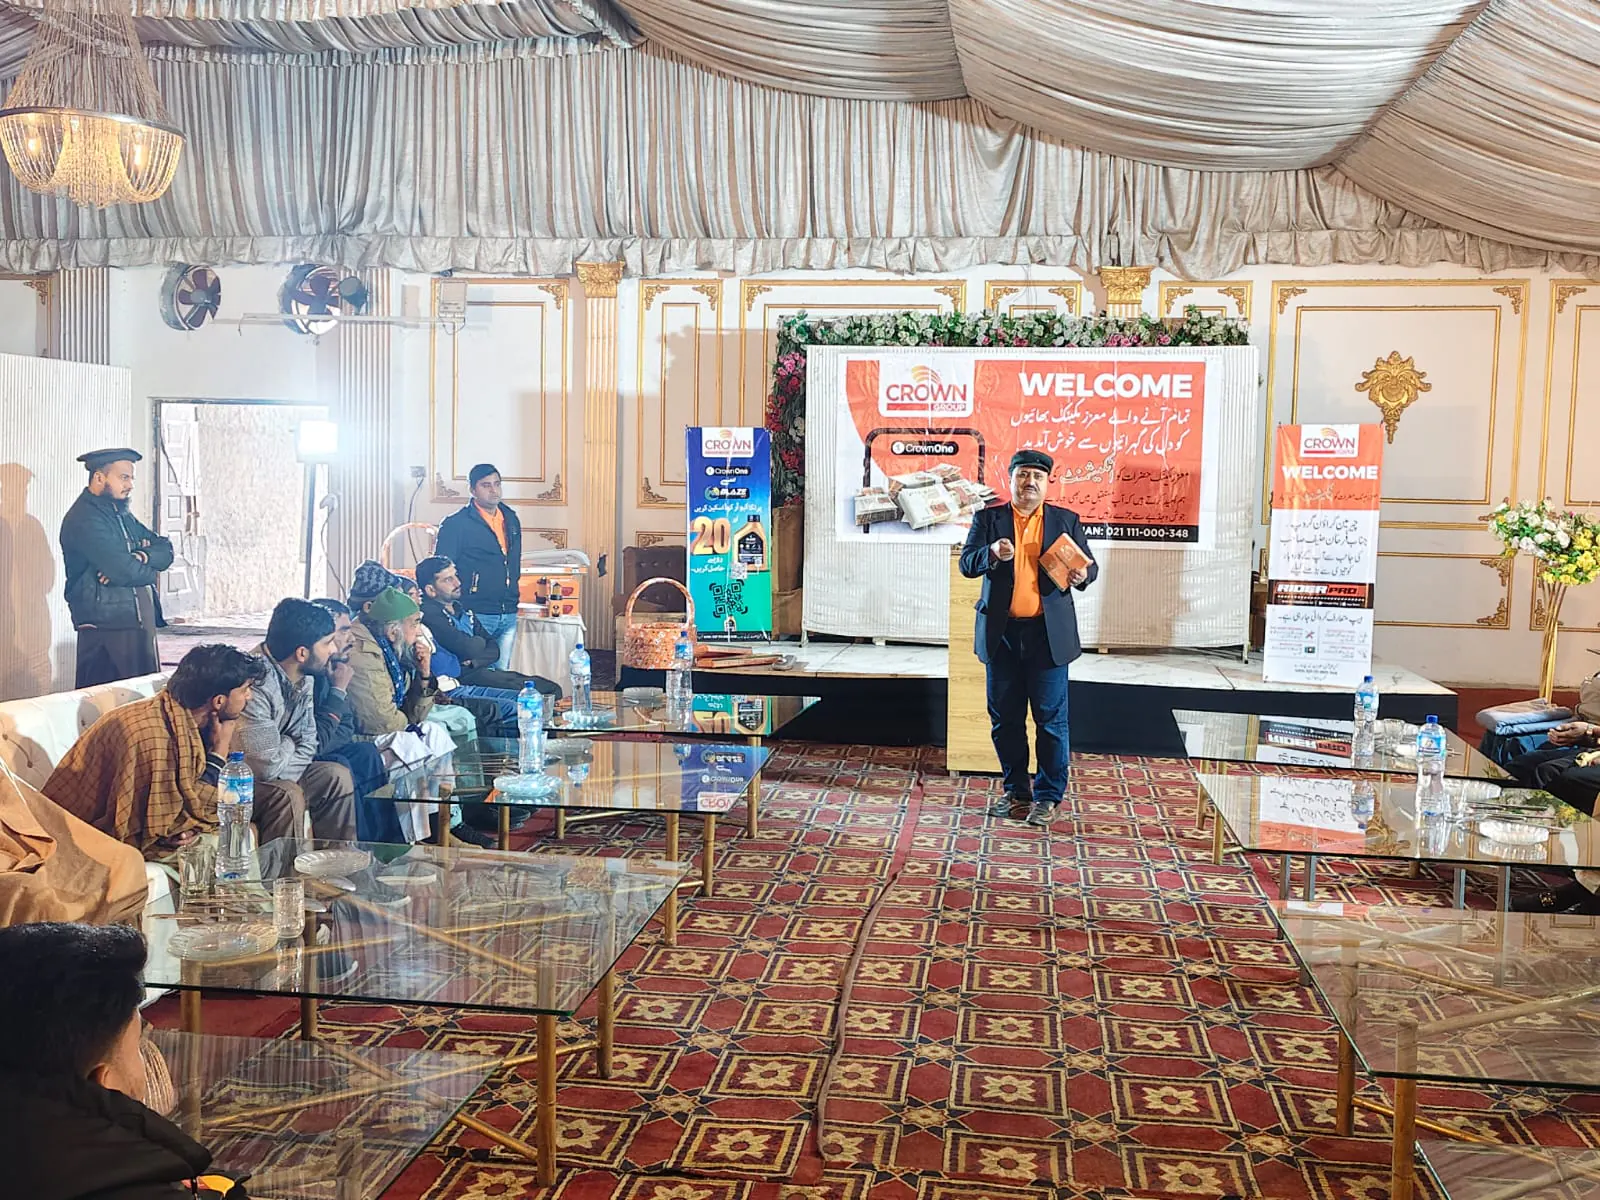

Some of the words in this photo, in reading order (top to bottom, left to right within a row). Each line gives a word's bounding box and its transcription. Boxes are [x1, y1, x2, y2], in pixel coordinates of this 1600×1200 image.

[1019, 372, 1192, 398] WELCOME
[886, 384, 967, 401] CROWN
[705, 439, 752, 450] CROWN
[905, 444, 954, 453] CrownOne
[1304, 437, 1355, 449] CROWN
[1282, 465, 1378, 480] WELCOME
[691, 516, 730, 554] 20
[1083, 527, 1104, 536] AN:
[1106, 527, 1124, 536] 021
[1127, 528, 1189, 538] 111-000-348
[1328, 587, 1358, 595] PRO
